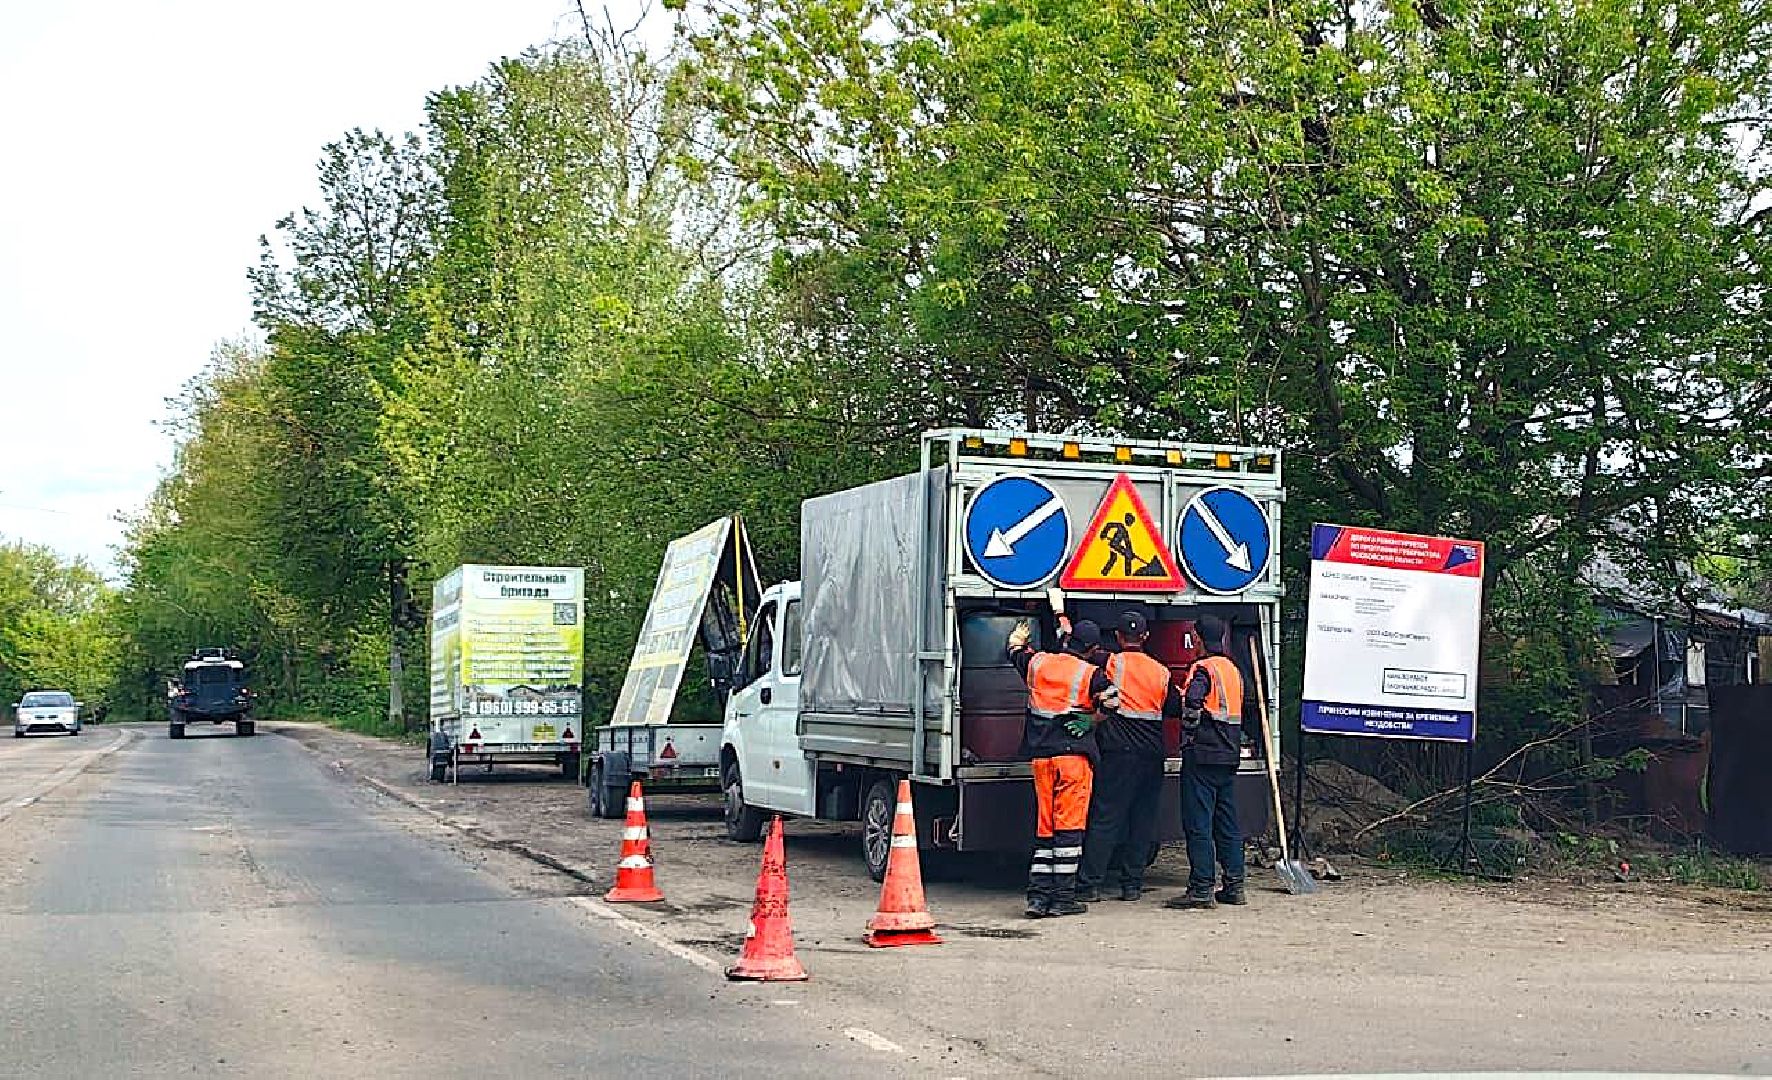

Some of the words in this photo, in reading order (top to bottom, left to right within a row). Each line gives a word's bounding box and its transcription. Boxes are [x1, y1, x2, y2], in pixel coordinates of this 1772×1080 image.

[483, 571, 567, 584] Строительная
[500, 585, 549, 598] бригада
[1318, 706, 1360, 716] ПРИНОСИМ
